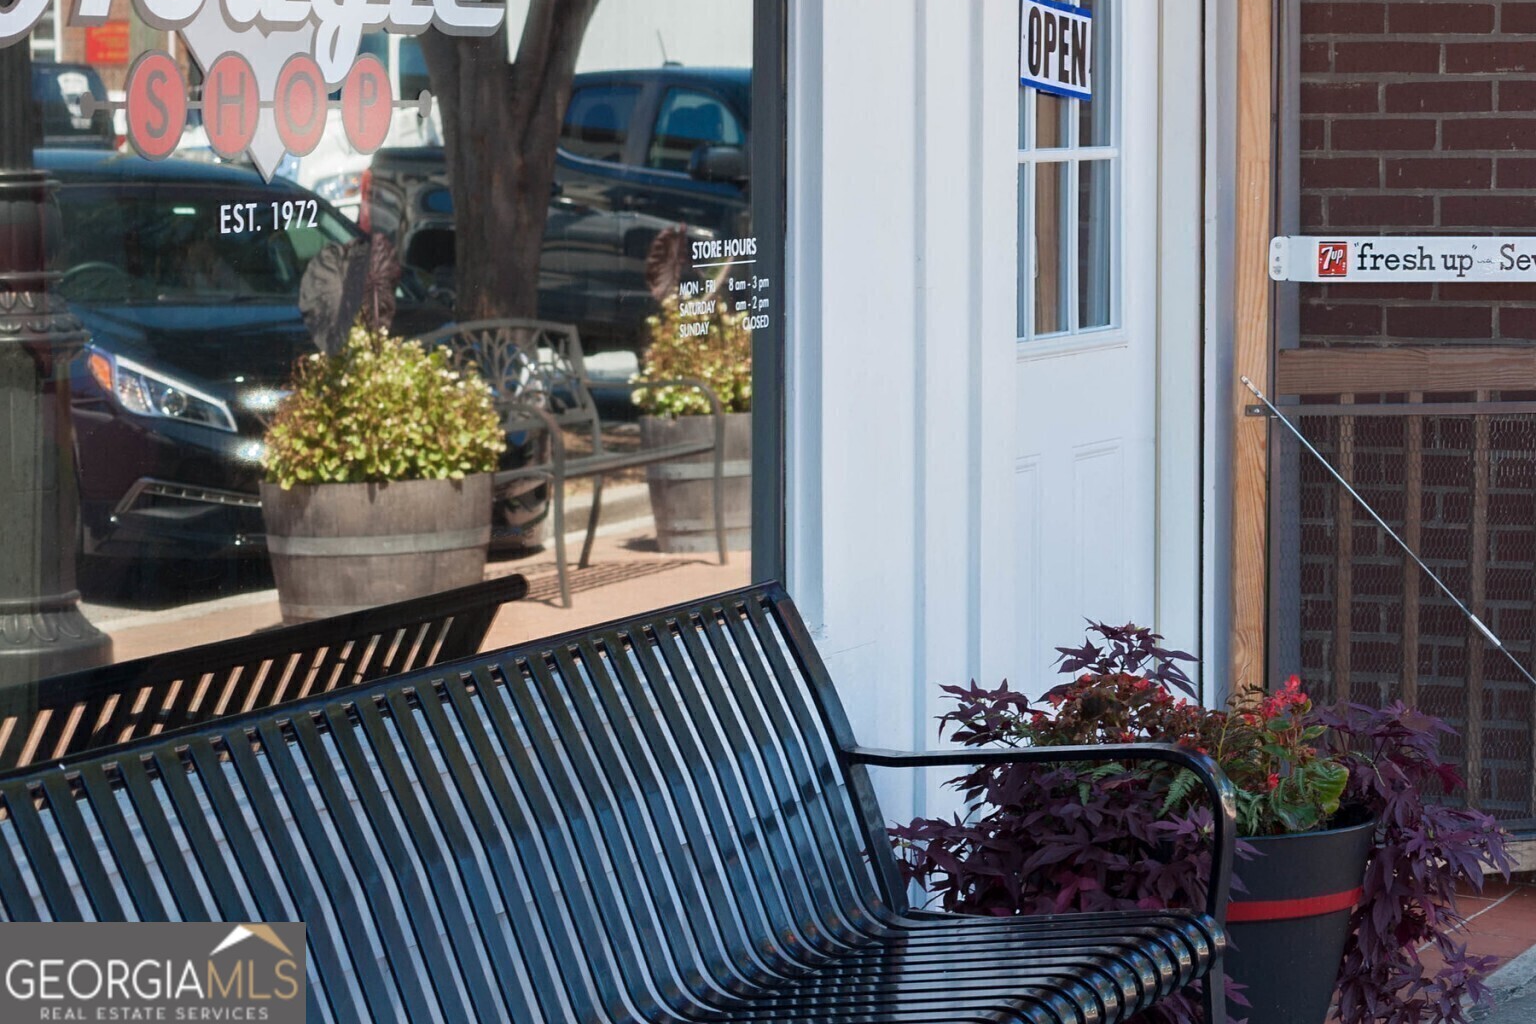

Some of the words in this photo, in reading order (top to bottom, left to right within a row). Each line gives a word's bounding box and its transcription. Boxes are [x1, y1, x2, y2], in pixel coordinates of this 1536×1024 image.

[1027, 6, 1087, 88] OPEN
[144, 69, 380, 139] SHOP
[220, 202, 262, 234] EST.
[271, 199, 318, 231] 1972
[692, 240, 722, 260] STORE
[724, 237, 757, 257] HOURS
[1320, 246, 1344, 271] 7up
[680, 280, 699, 295] MON
[735, 280, 746, 291] am
[752, 275, 758, 289] 3
[758, 278, 769, 292] pm
[680, 299, 716, 317] SATURDAY
[735, 300, 747, 311] am
[752, 295, 758, 309] 2
[758, 298, 769, 312] pm
[680, 321, 710, 338] SUNDAY
[742, 314, 770, 331] CLOSED
